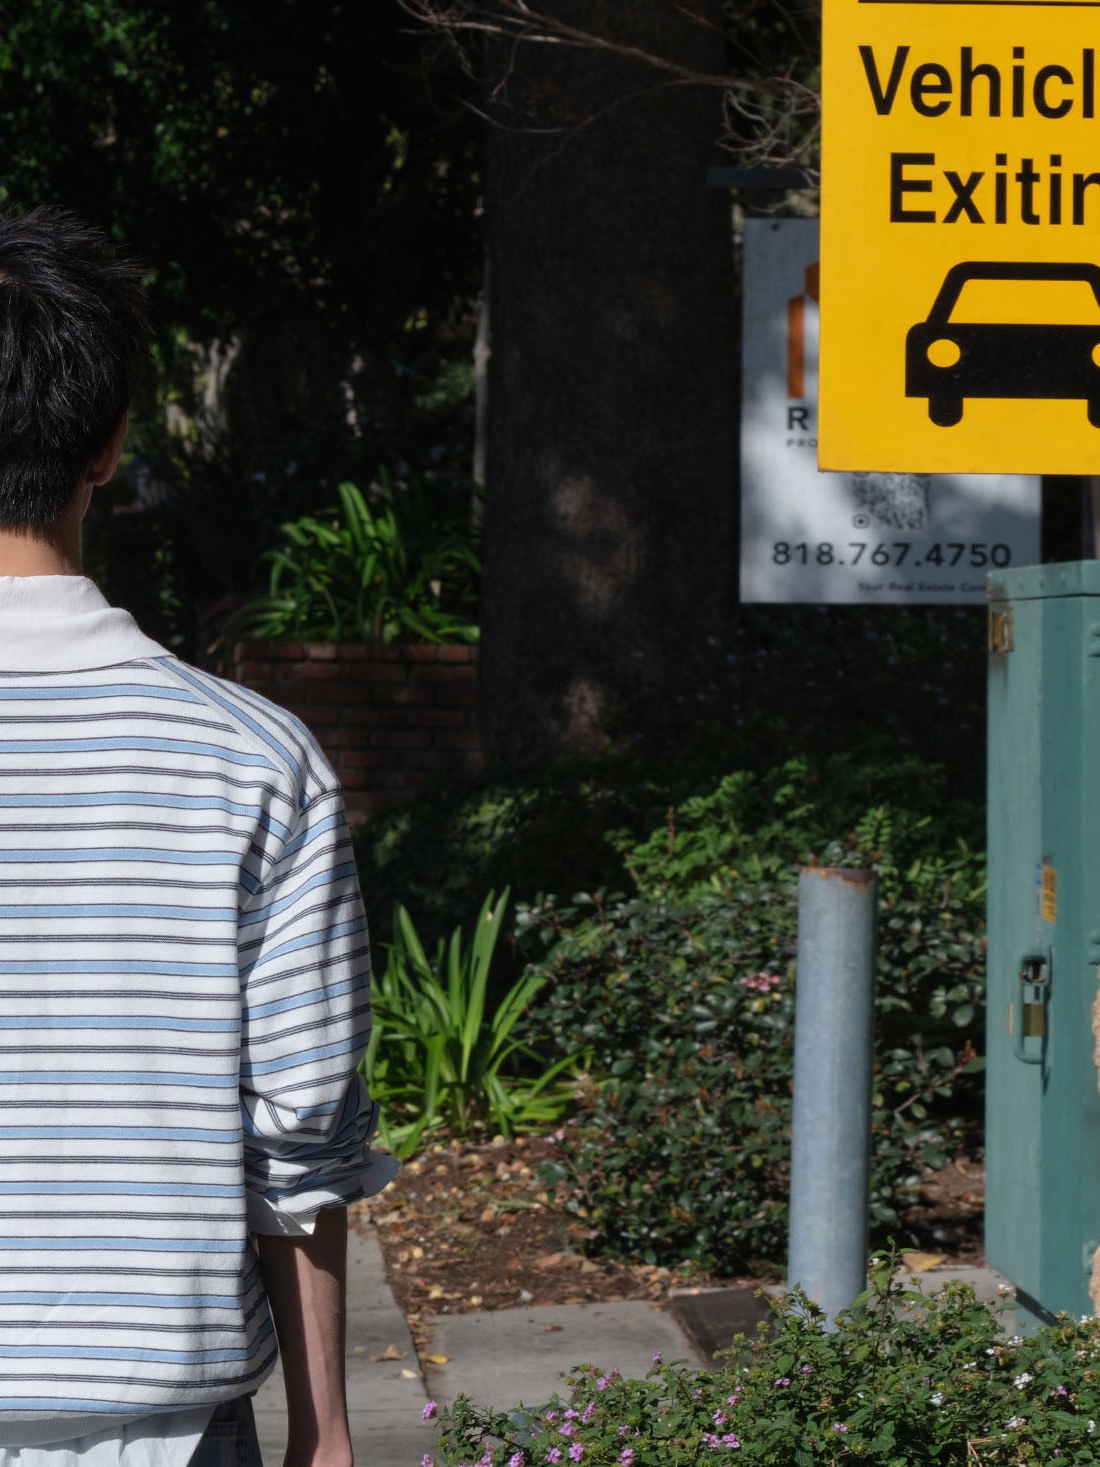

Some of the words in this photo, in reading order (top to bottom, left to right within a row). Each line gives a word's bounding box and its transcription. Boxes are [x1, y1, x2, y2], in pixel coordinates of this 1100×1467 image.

[772, 541, 1012, 568] 818.767.4750
[889, 581, 915, 592] Real
[917, 581, 955, 593] Estate
